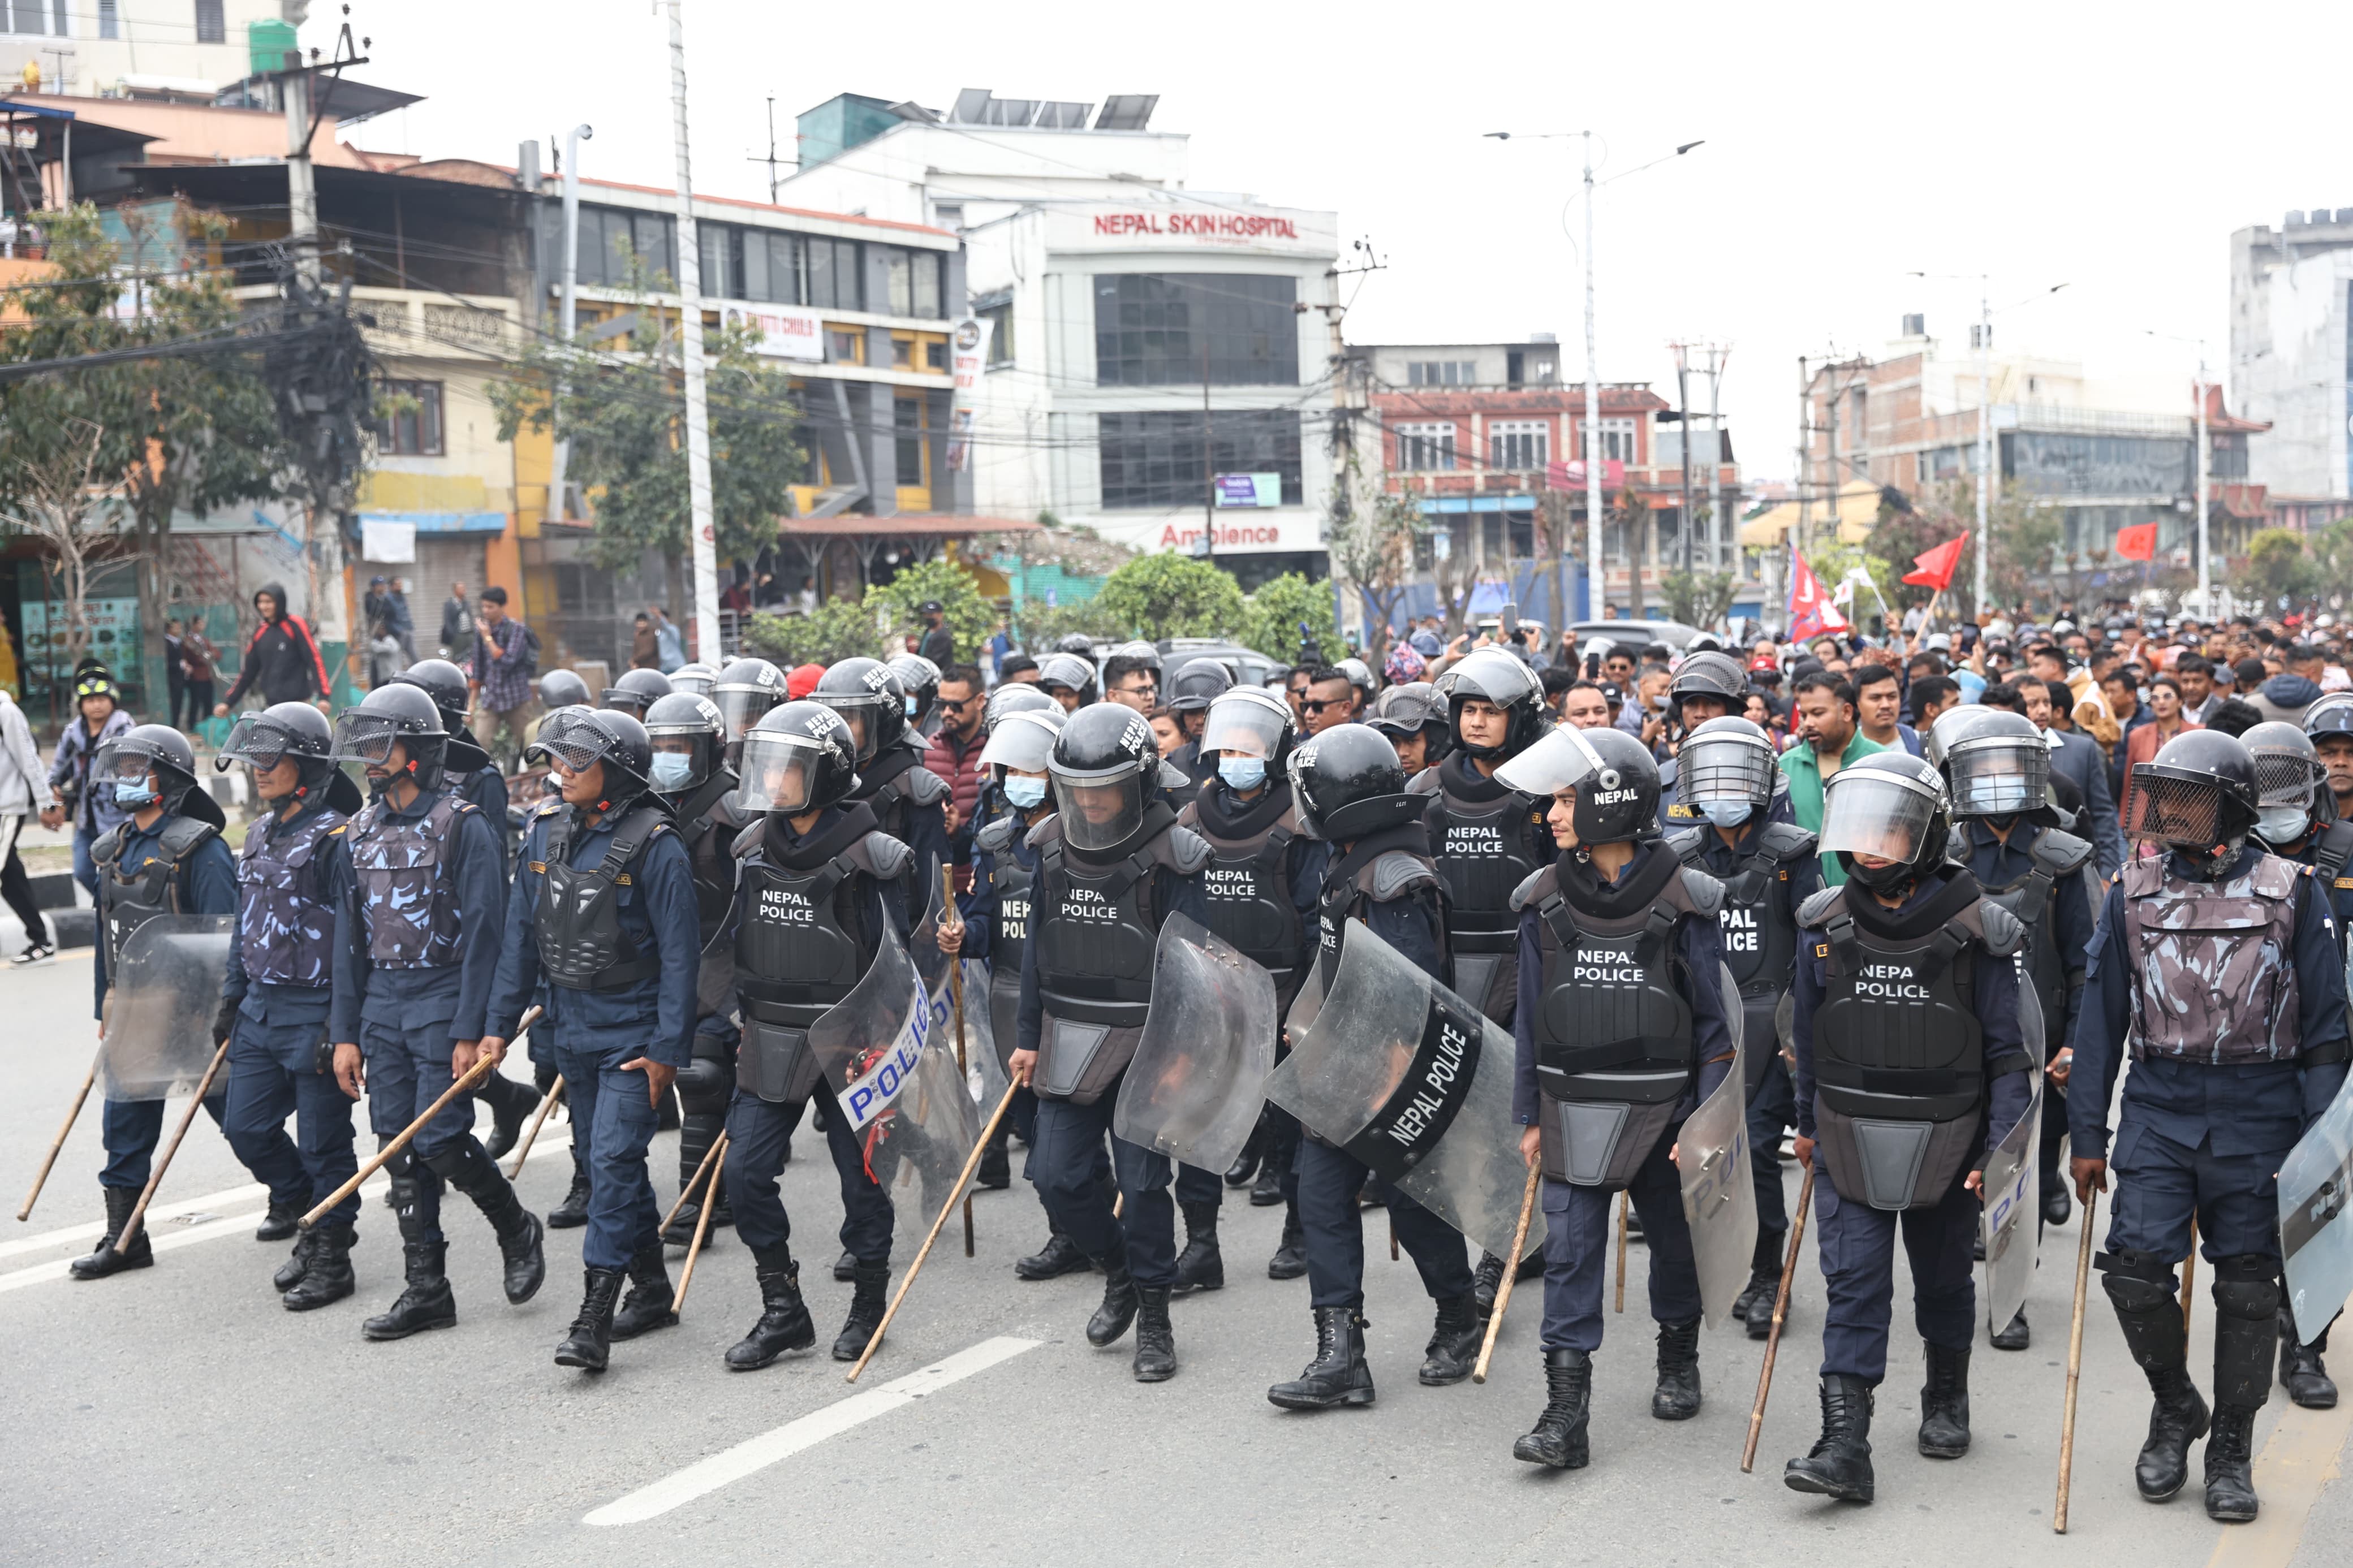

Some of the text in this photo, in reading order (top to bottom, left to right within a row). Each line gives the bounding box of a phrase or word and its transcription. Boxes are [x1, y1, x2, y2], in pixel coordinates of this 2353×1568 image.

[1095, 214, 1298, 238] NEPAL SKIN HOSPITAL
[869, 669, 893, 691] POLICE
[805, 710, 834, 731] NEPAL
[812, 716, 841, 738] POLICE
[1119, 717, 1140, 748] NEPAL
[1128, 722, 1147, 755] POLICE
[1299, 746, 1318, 758] EPAL
[1298, 757, 1316, 768] OLICE
[1594, 788, 1638, 805] NEPAL
[1667, 804, 1693, 818] NEPA
[1447, 827, 1501, 838] NEPAL
[1446, 841, 1503, 853] POLICE
[1205, 870, 1253, 882] NEPAL
[762, 889, 812, 906] NEPAL
[1065, 889, 1105, 902] NEPA
[760, 905, 813, 922] POLICE
[1002, 900, 1031, 918] NEP
[1062, 904, 1117, 918] POLICE
[1321, 915, 1335, 931] EPAL
[1720, 909, 1757, 928] PAL
[1002, 921, 1026, 939] POL
[1321, 930, 1336, 948] OLICE
[1726, 932, 1757, 951] ICE
[1574, 967, 1644, 982] POLICE
[1859, 965, 1914, 979] NEPA
[1855, 982, 1930, 998] POLICE
[1388, 1023, 1466, 1147] NEPAL POLICE
